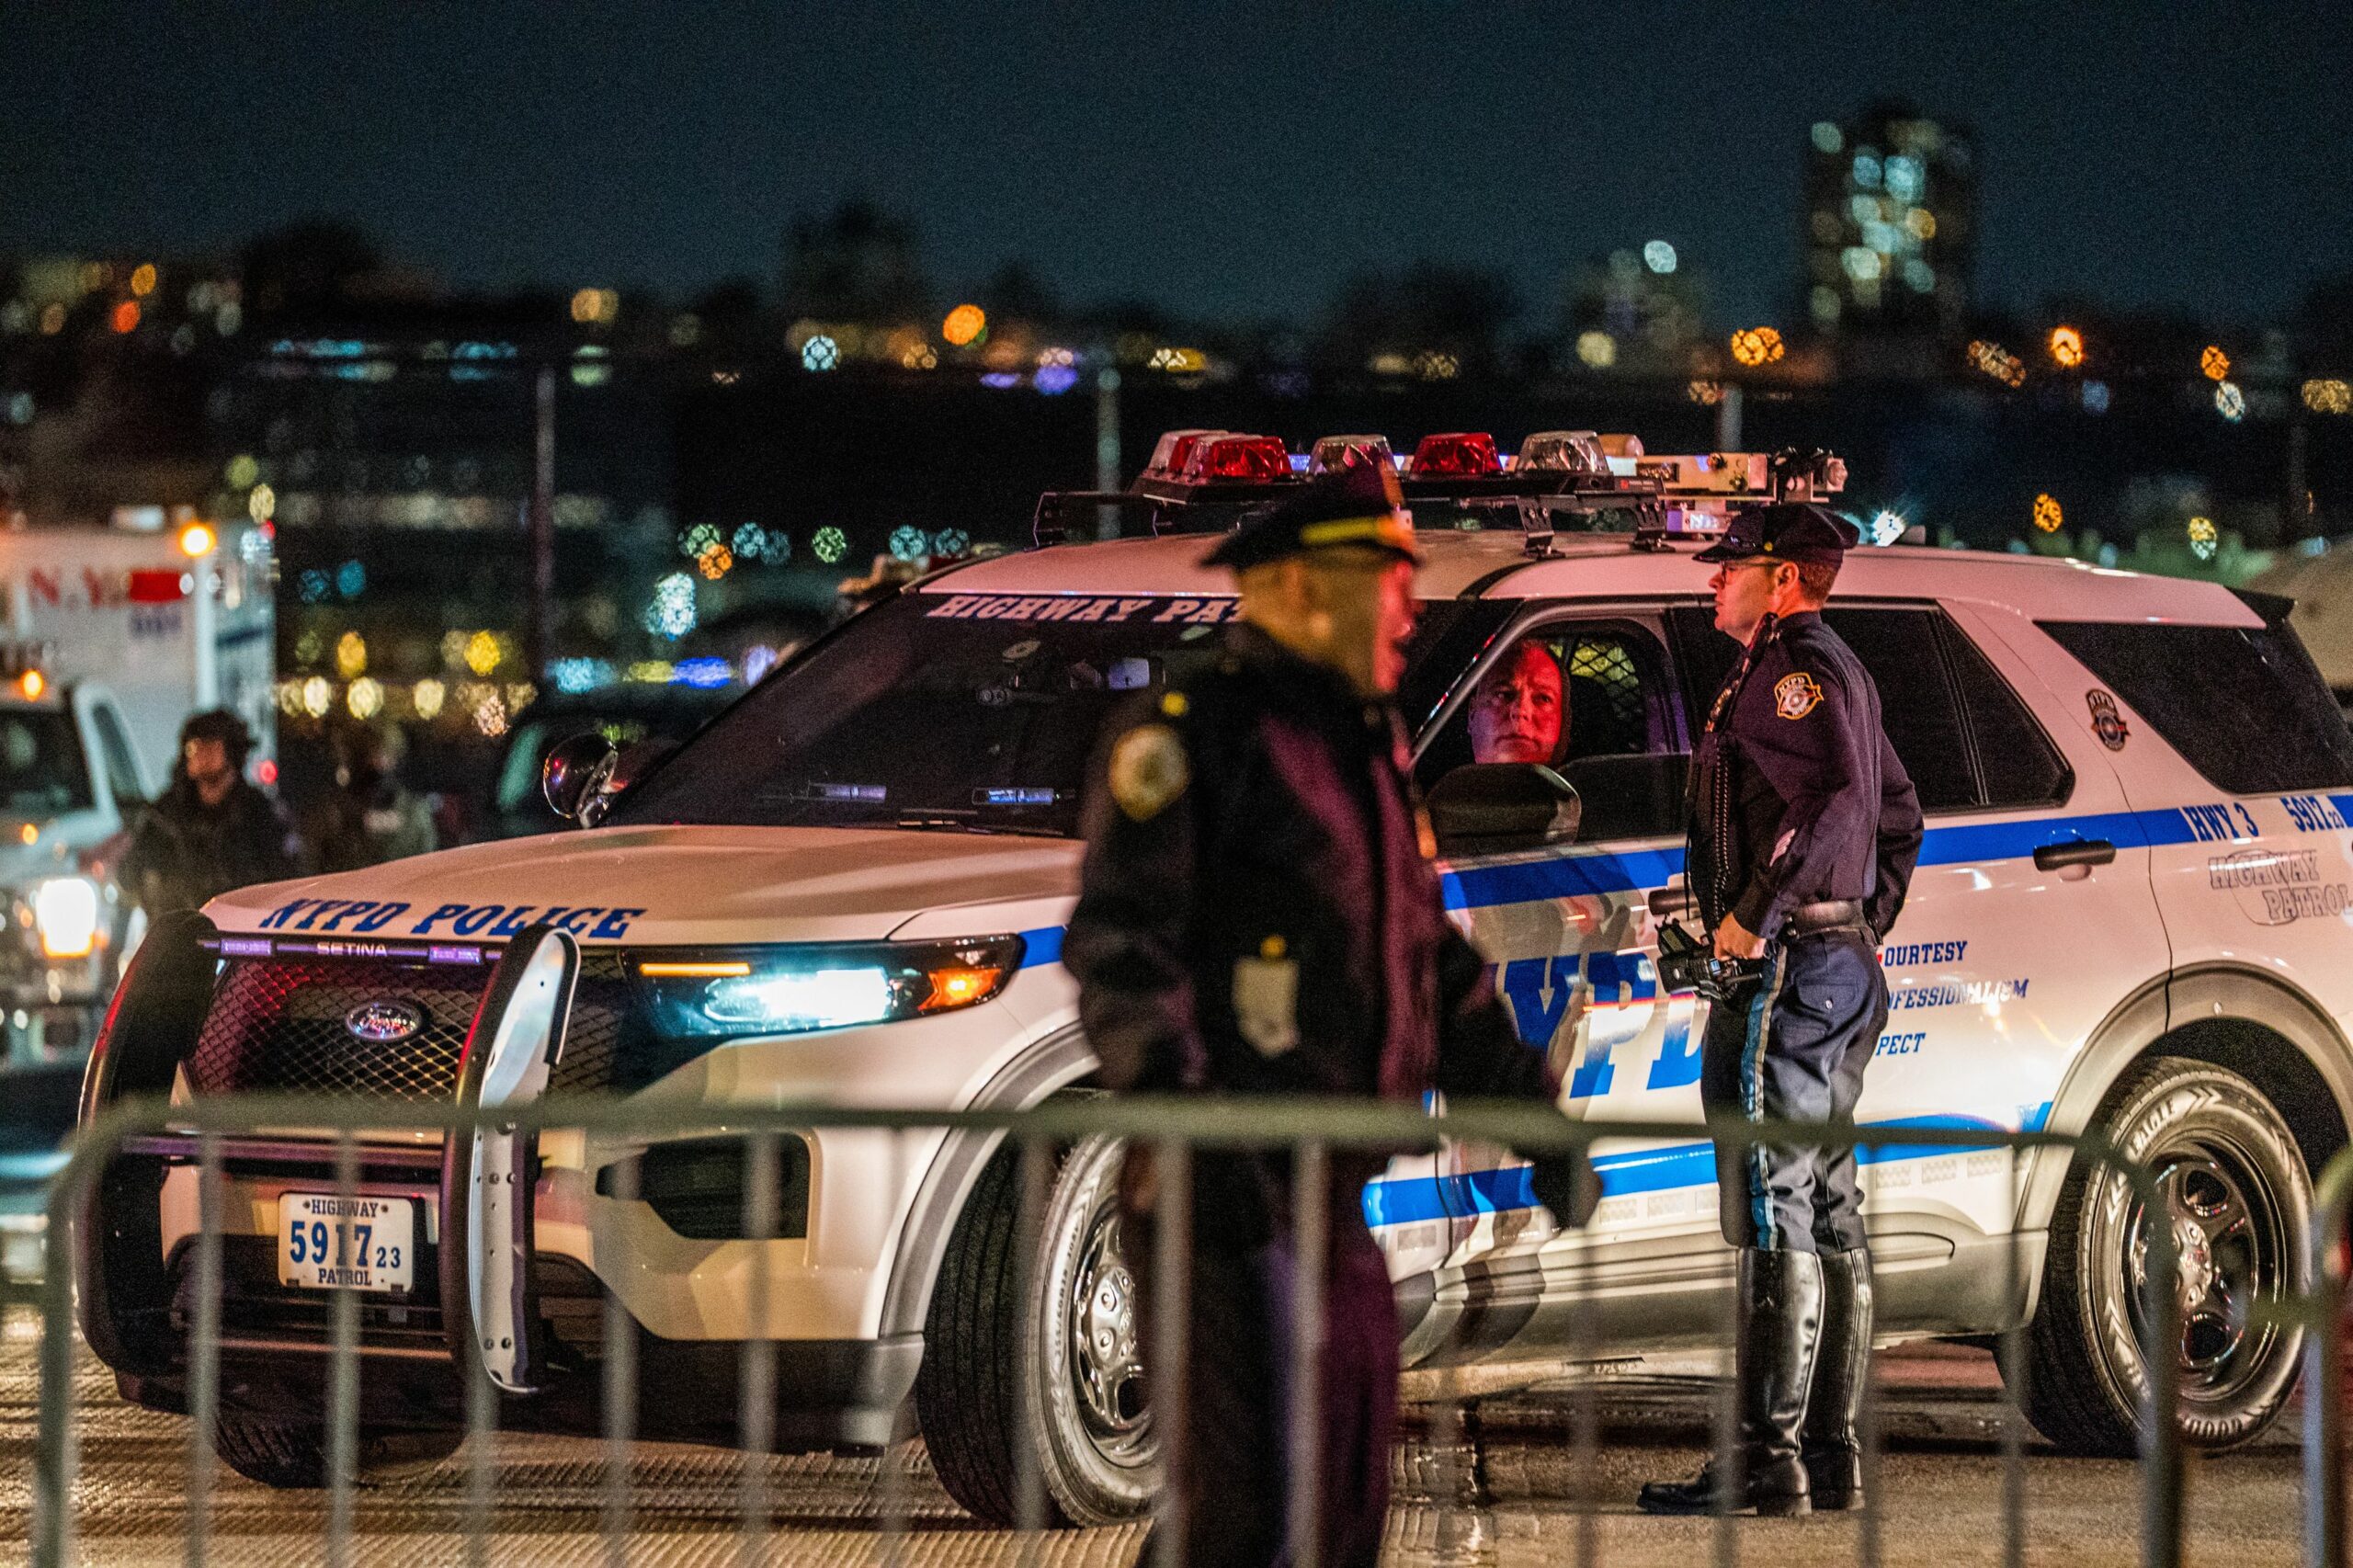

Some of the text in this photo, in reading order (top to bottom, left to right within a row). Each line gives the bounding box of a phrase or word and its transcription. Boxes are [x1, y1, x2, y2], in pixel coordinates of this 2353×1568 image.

[924, 596, 1155, 622] HIGHWAY
[2181, 801, 2260, 842] HWY 3
[2279, 795, 2334, 833] 5917
[2208, 848, 2321, 890] HIGHWAY
[258, 898, 648, 939] NYPD POLICE
[316, 941, 388, 957] SETINA
[1877, 940, 1968, 967] OURTESY
[1485, 951, 1710, 1099] YPD
[1876, 1032, 1927, 1056] PECT
[311, 1199, 379, 1218] HIGHWAY
[290, 1221, 401, 1268] 5917 23
[318, 1267, 372, 1286] PATROL
